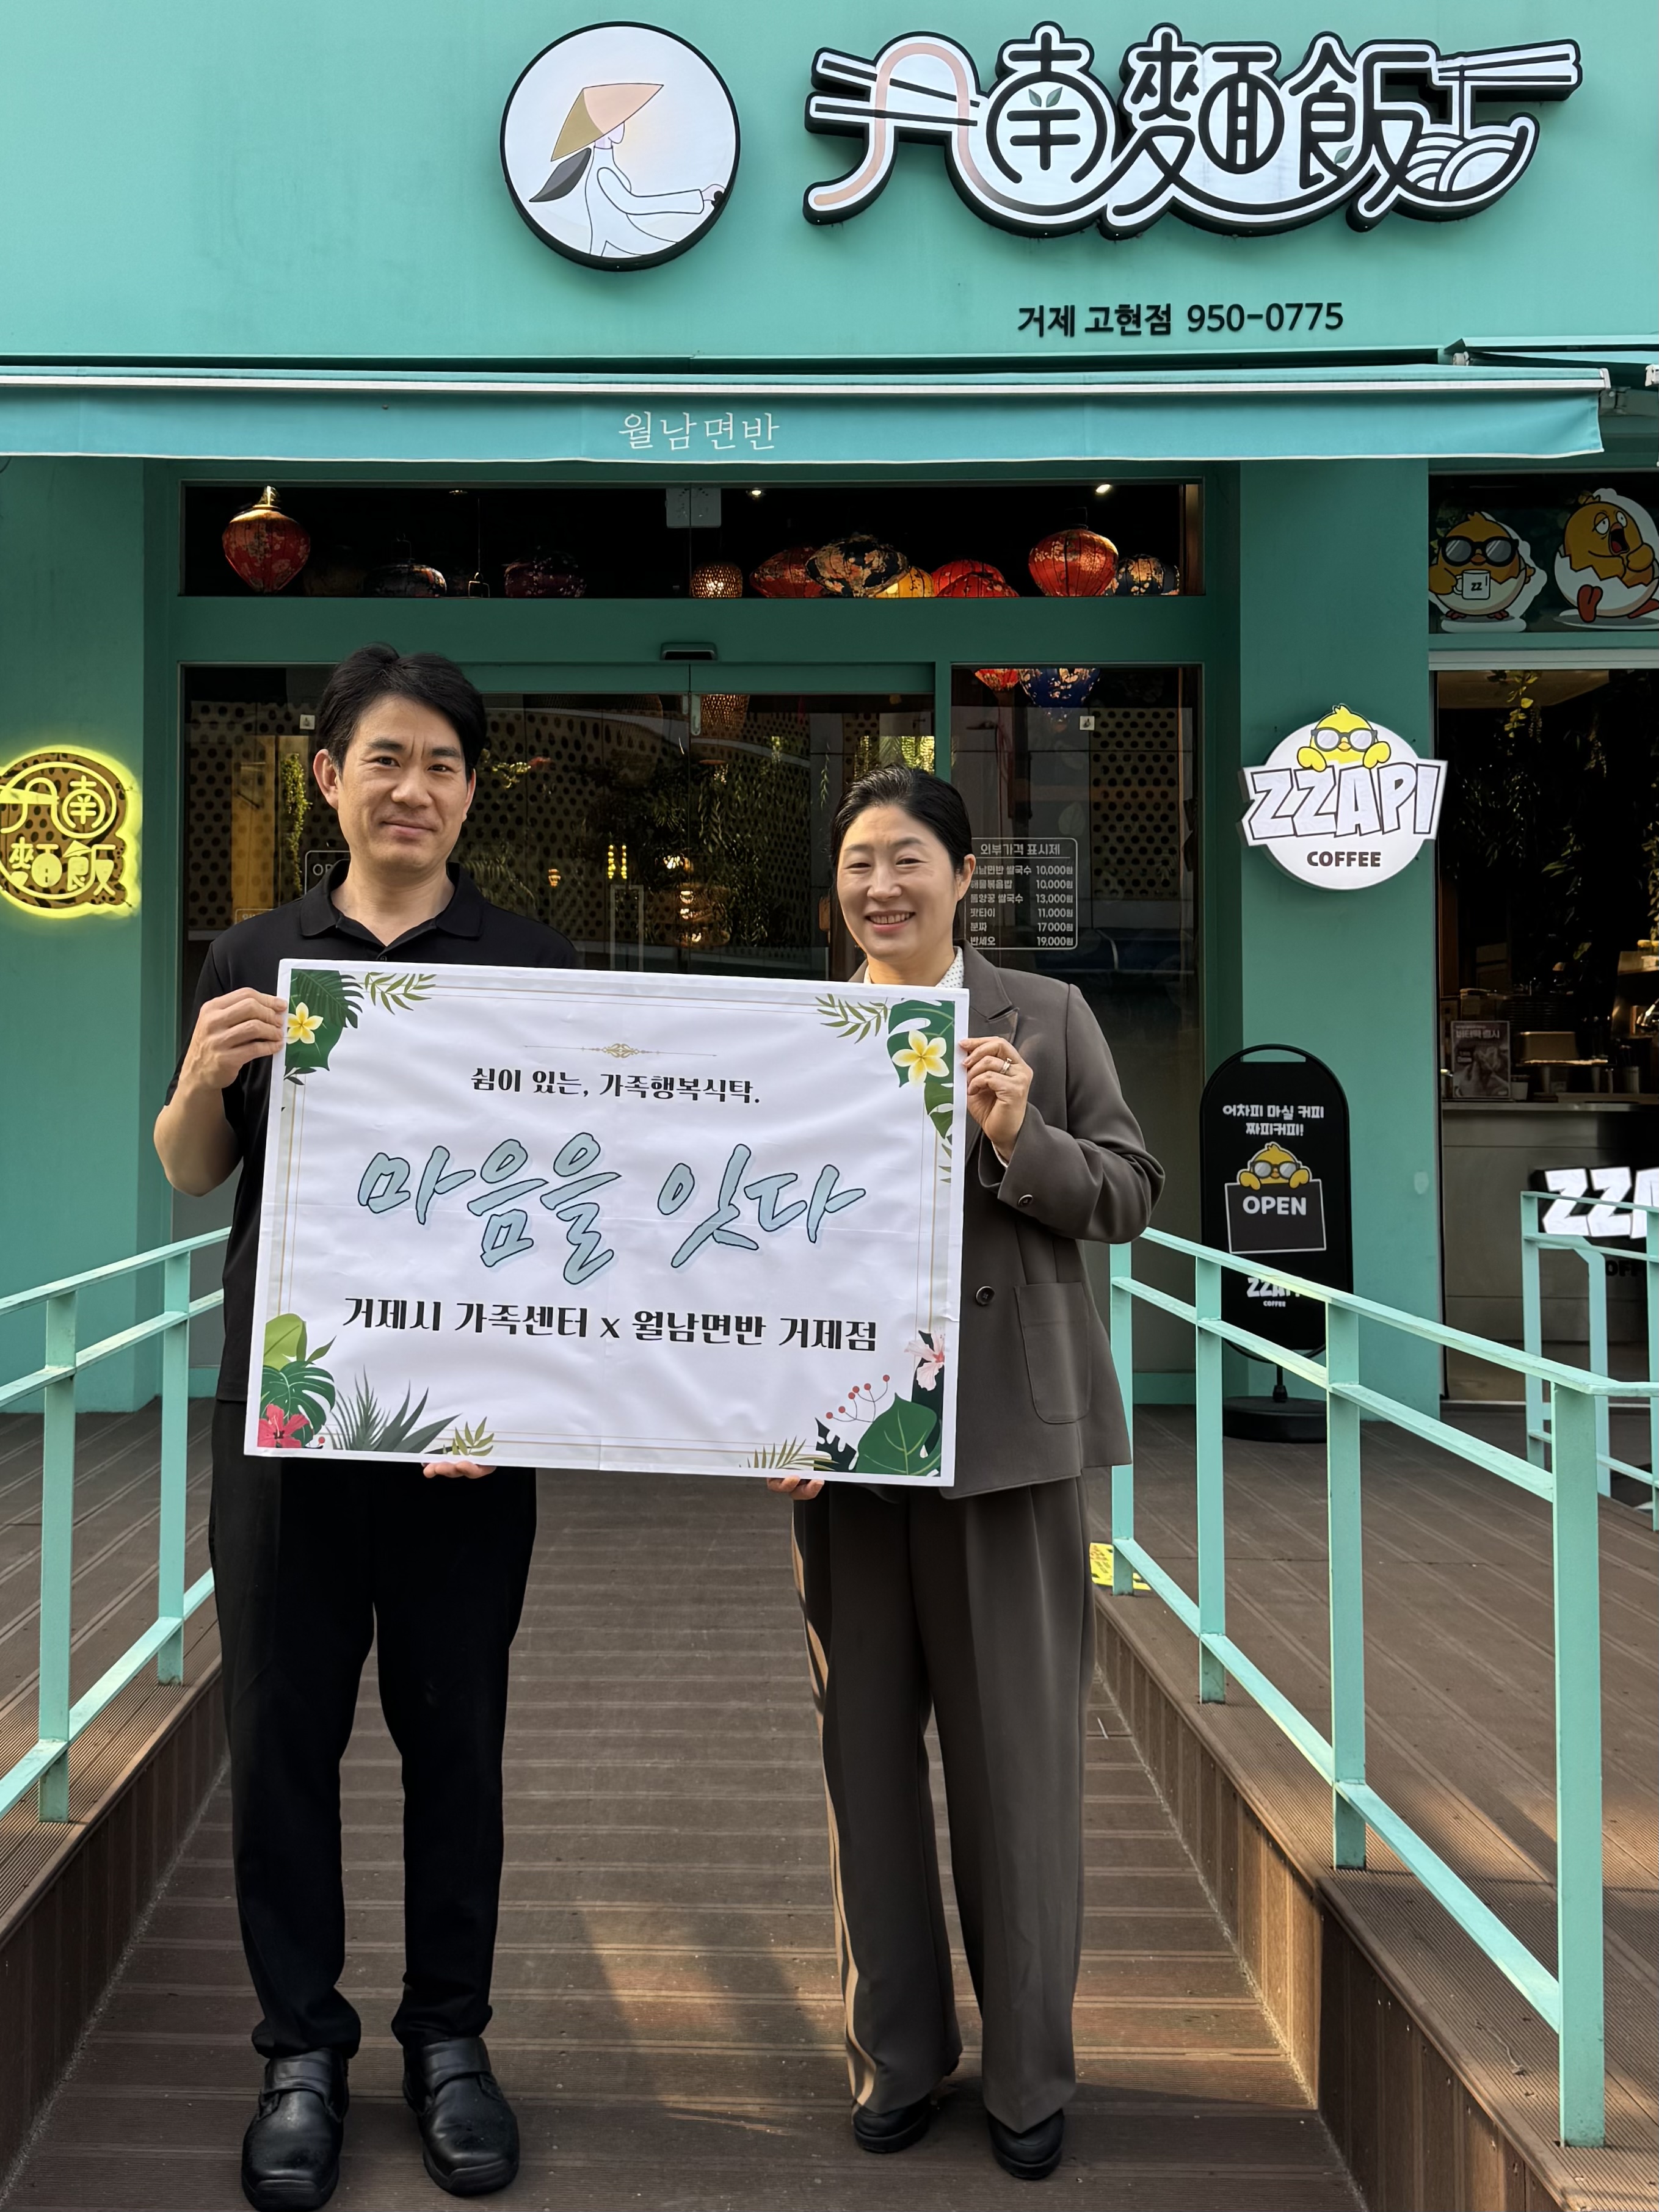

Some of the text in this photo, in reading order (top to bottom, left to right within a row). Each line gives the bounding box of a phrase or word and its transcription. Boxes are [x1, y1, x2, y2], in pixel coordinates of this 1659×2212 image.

[1017, 302, 1343, 337] 거제 고현점 950-0775
[618, 411, 780, 451] 월남면반
[1248, 762, 1441, 841] ZZAPI
[1027, 843, 1061, 855] 표시제
[1307, 851, 1381, 867] COFFEE
[1006, 865, 1032, 876] 쌀국수
[1036, 866, 1073, 876] 10,000원
[1036, 880, 1073, 890] 10,000원
[998, 893, 1023, 904] 쌀국수
[1036, 894, 1073, 904] 13,000원
[970, 908, 1073, 918] 팟타이 11,000원
[970, 936, 1073, 947] 반세오 19,000원
[471, 1067, 761, 1104] 쉼이 있는, 가족행복식탁.
[1222, 1104, 1324, 1120] 어차피 마실 커피
[1246, 1122, 1304, 1136] 짜피커피!
[357, 1131, 866, 1285] 마음을 잇다
[1242, 1195, 1307, 1216] OPEN
[342, 1296, 441, 1331] 거제시
[454, 1302, 588, 1338] 가족센터
[631, 1310, 767, 1346] 월남면반
[777, 1316, 877, 1352] 거제점
